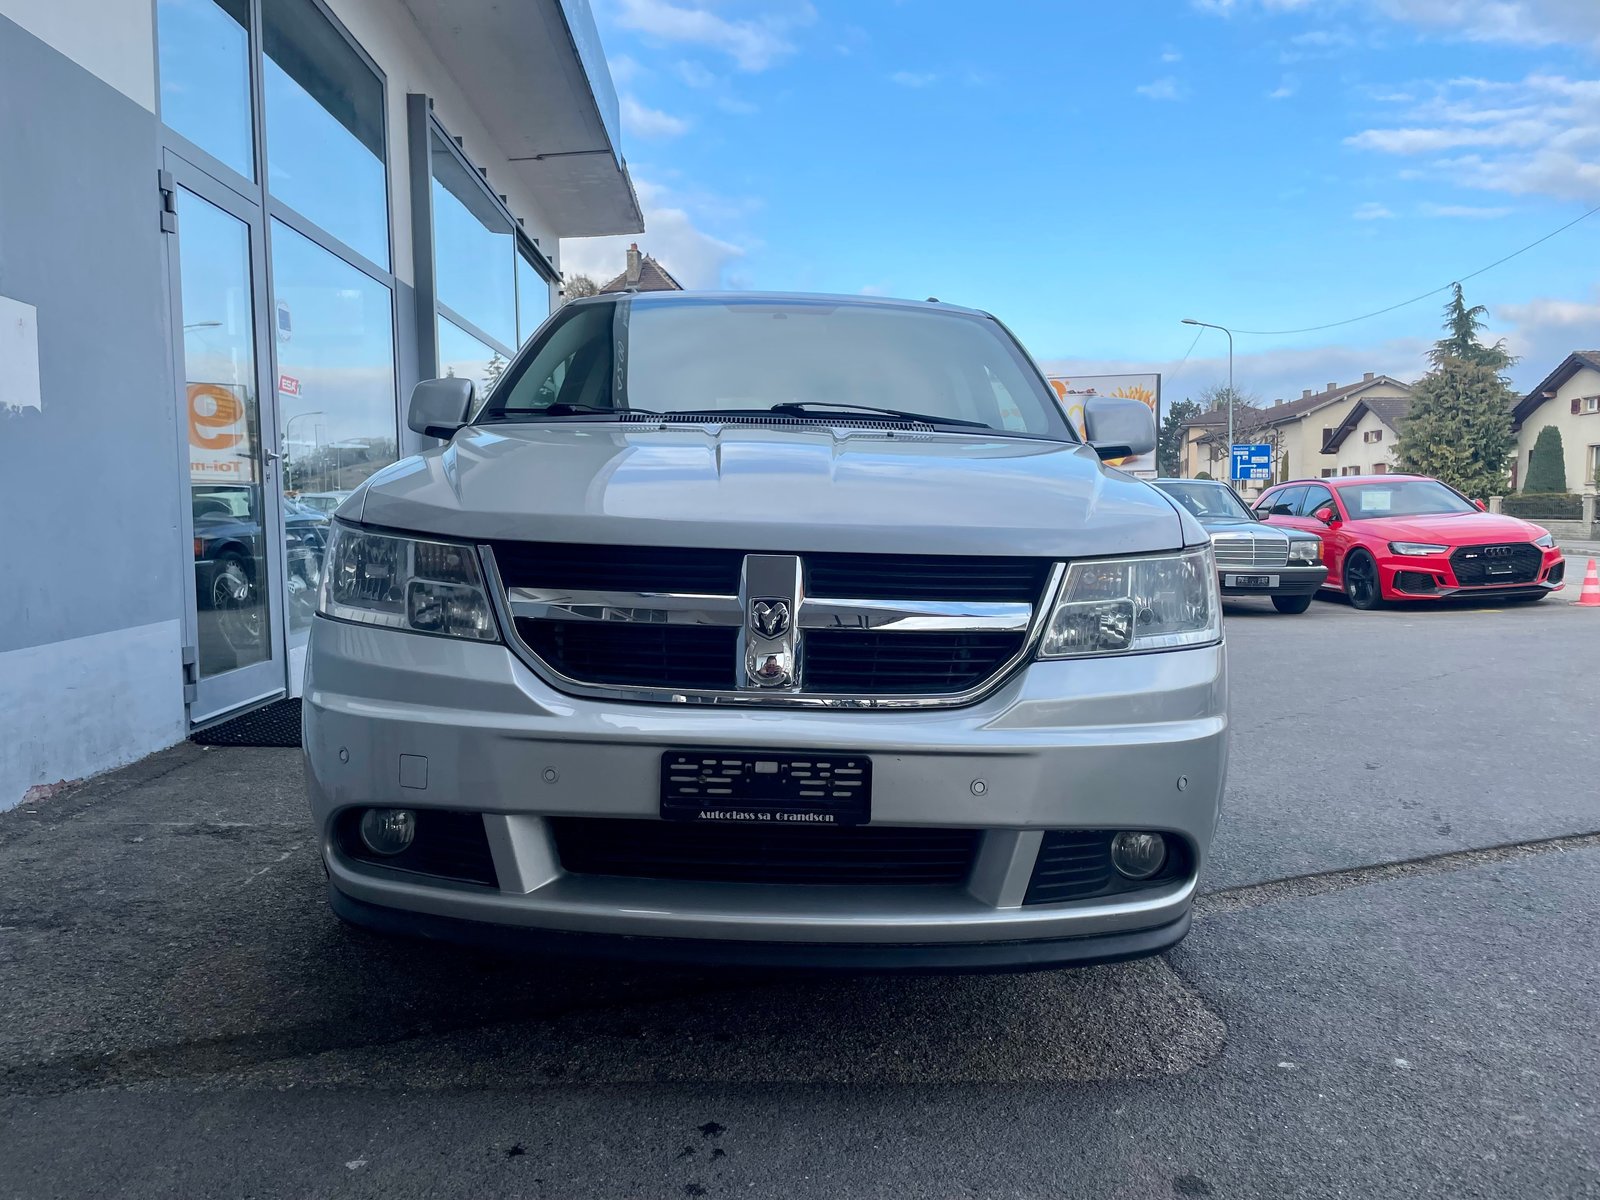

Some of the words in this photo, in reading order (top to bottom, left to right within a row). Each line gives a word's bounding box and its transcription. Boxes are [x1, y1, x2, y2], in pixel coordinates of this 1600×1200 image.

[698, 810, 755, 820] Autoclass
[757, 812, 771, 821] sa
[775, 812, 834, 822] Grandson
